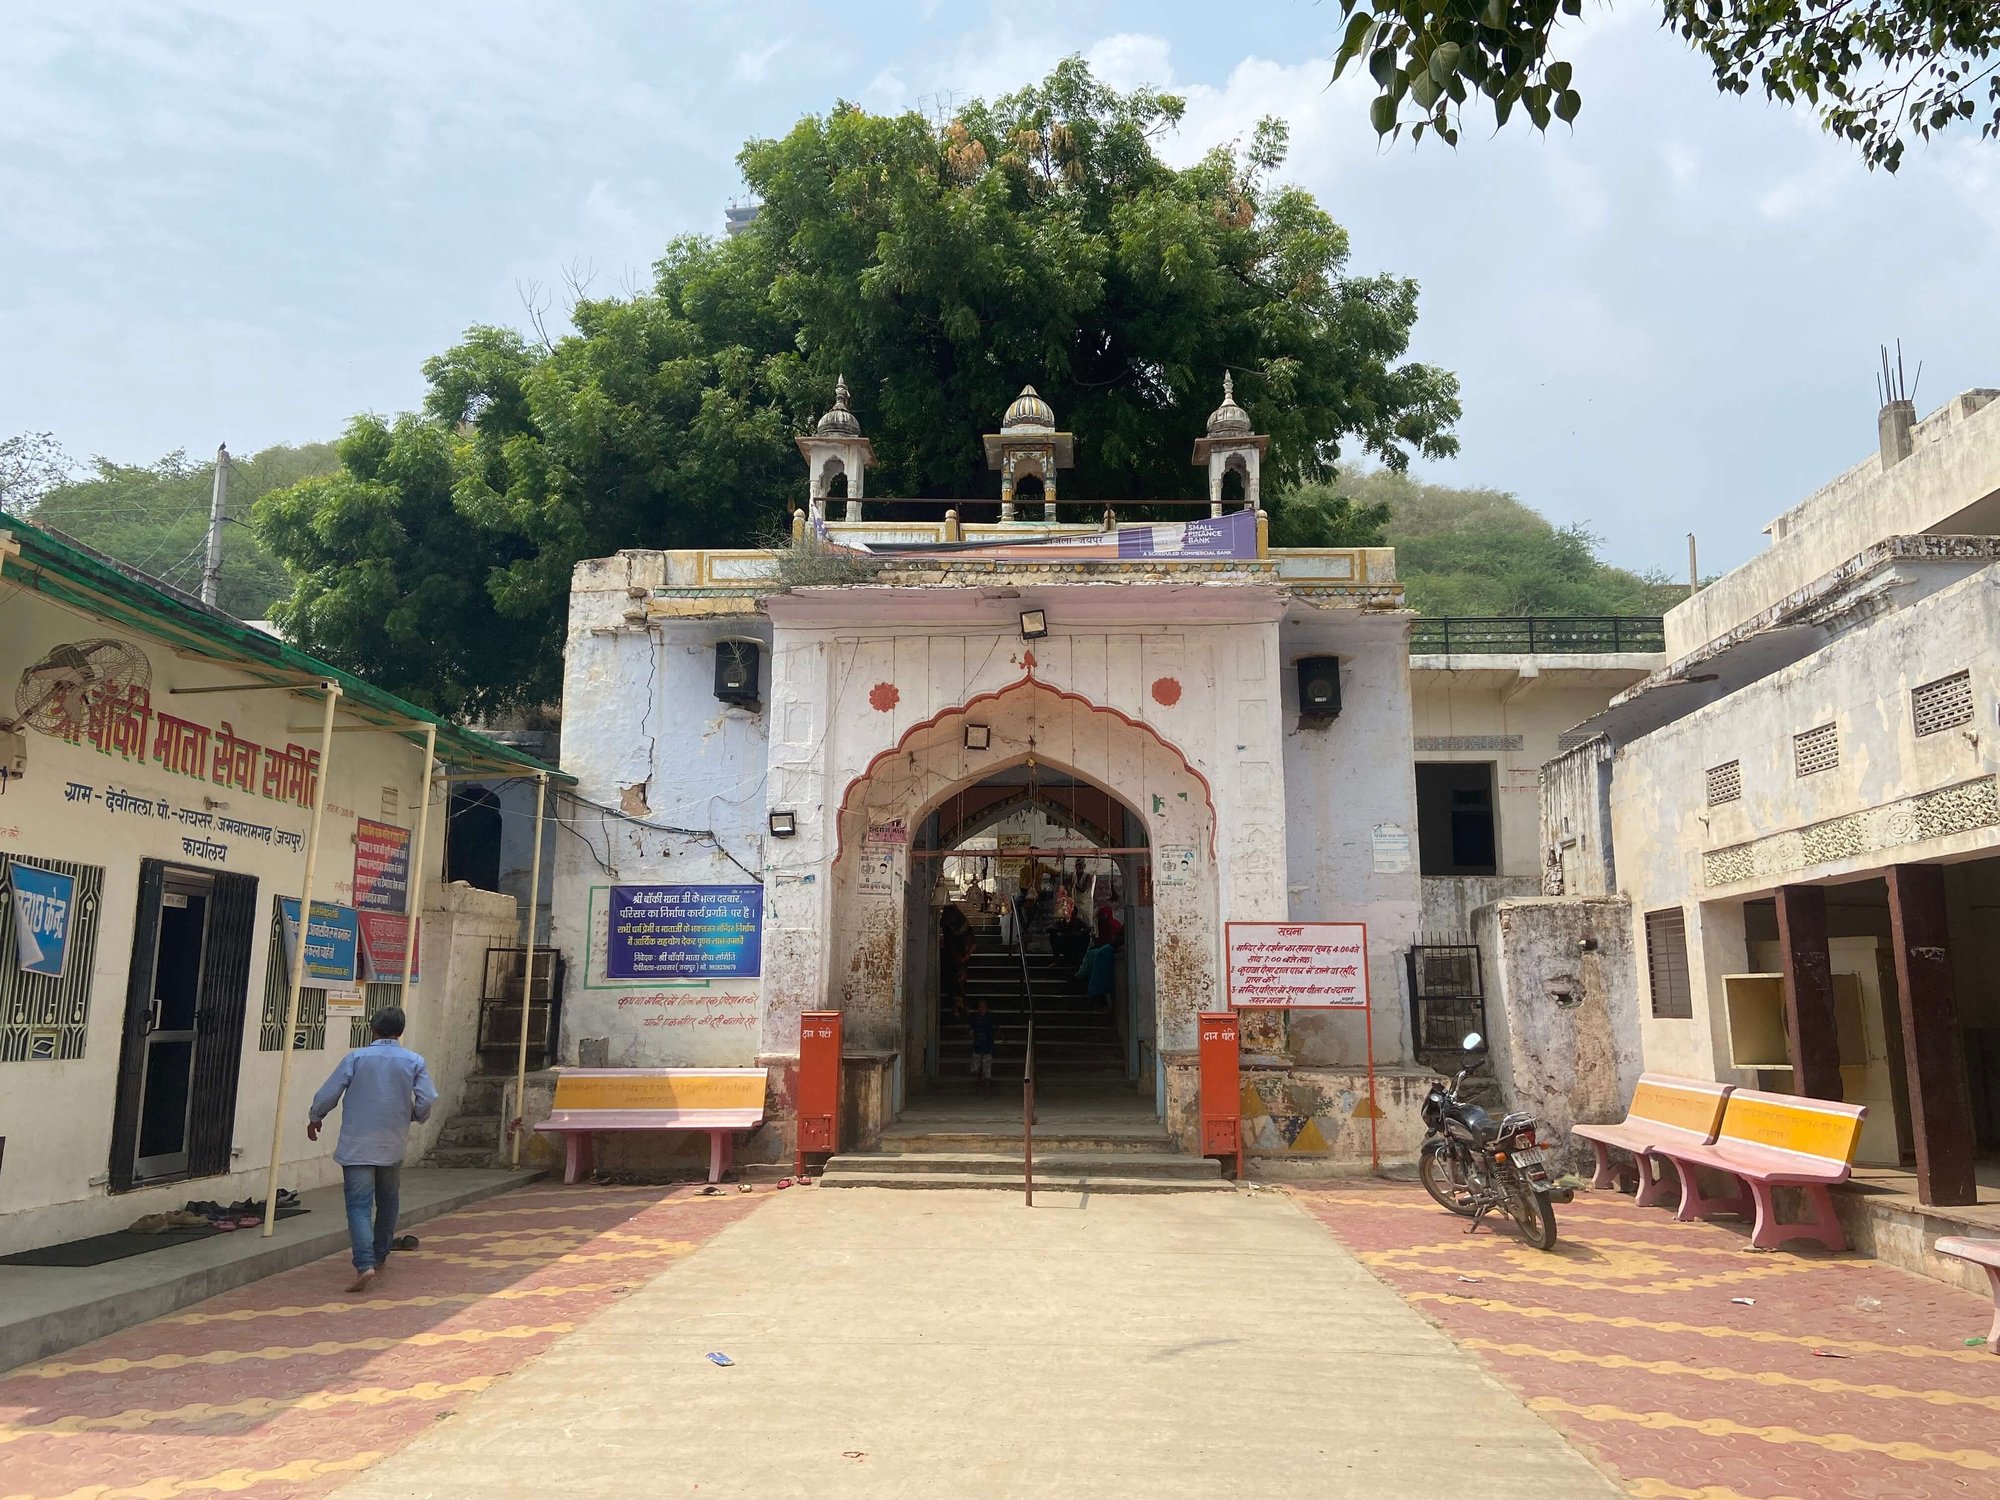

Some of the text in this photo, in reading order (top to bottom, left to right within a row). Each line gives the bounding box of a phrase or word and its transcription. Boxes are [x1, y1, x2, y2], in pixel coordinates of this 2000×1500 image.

[153, 711, 212, 782] माता
[212, 720, 263, 795] सेवा
[65, 782, 93, 804] ग्राम
[182, 836, 227, 862] कार्यालय
[633, 892, 643, 904] श्री
[664, 895, 680, 904] माता
[681, 891, 691, 904] जी
[691, 892, 700, 904] के
[700, 895, 716, 904] भव्य
[620, 906, 647, 919] परिसर
[647, 909, 659, 918] का
[660, 906, 686, 918] निर्माण
[687, 905, 706, 918] कार्य
[705, 905, 728, 919] प्रगति
[731, 909, 742, 918] पर
[743, 905, 750, 919] है
[617, 922, 631, 934] सभी
[683, 922, 691, 933] के
[736, 922, 756, 933] निर्माण
[1278, 927, 1305, 938] सूचना
[633, 935, 656, 946] आर्थिक
[657, 935, 680, 946] सहयोग
[681, 935, 697, 946] देकर
[1236, 942, 1258, 954] मन्दिर
[1266, 942, 1286, 953] दर्शन
[1295, 945, 1316, 954] समय
[1314, 945, 1333, 955] सुबह
[659, 951, 668, 962] श्री
[701, 951, 714, 961] सेवा
[715, 951, 736, 961] समिति
[1282, 954, 1298, 963] बजे
[1238, 966, 1261, 976] कृपया
[1274, 966, 1290, 974] दान
[618, 996, 644, 1009] कृपया
[802, 1027, 832, 1039] दान पेटी
[1203, 1028, 1235, 1041] दान पेटी
